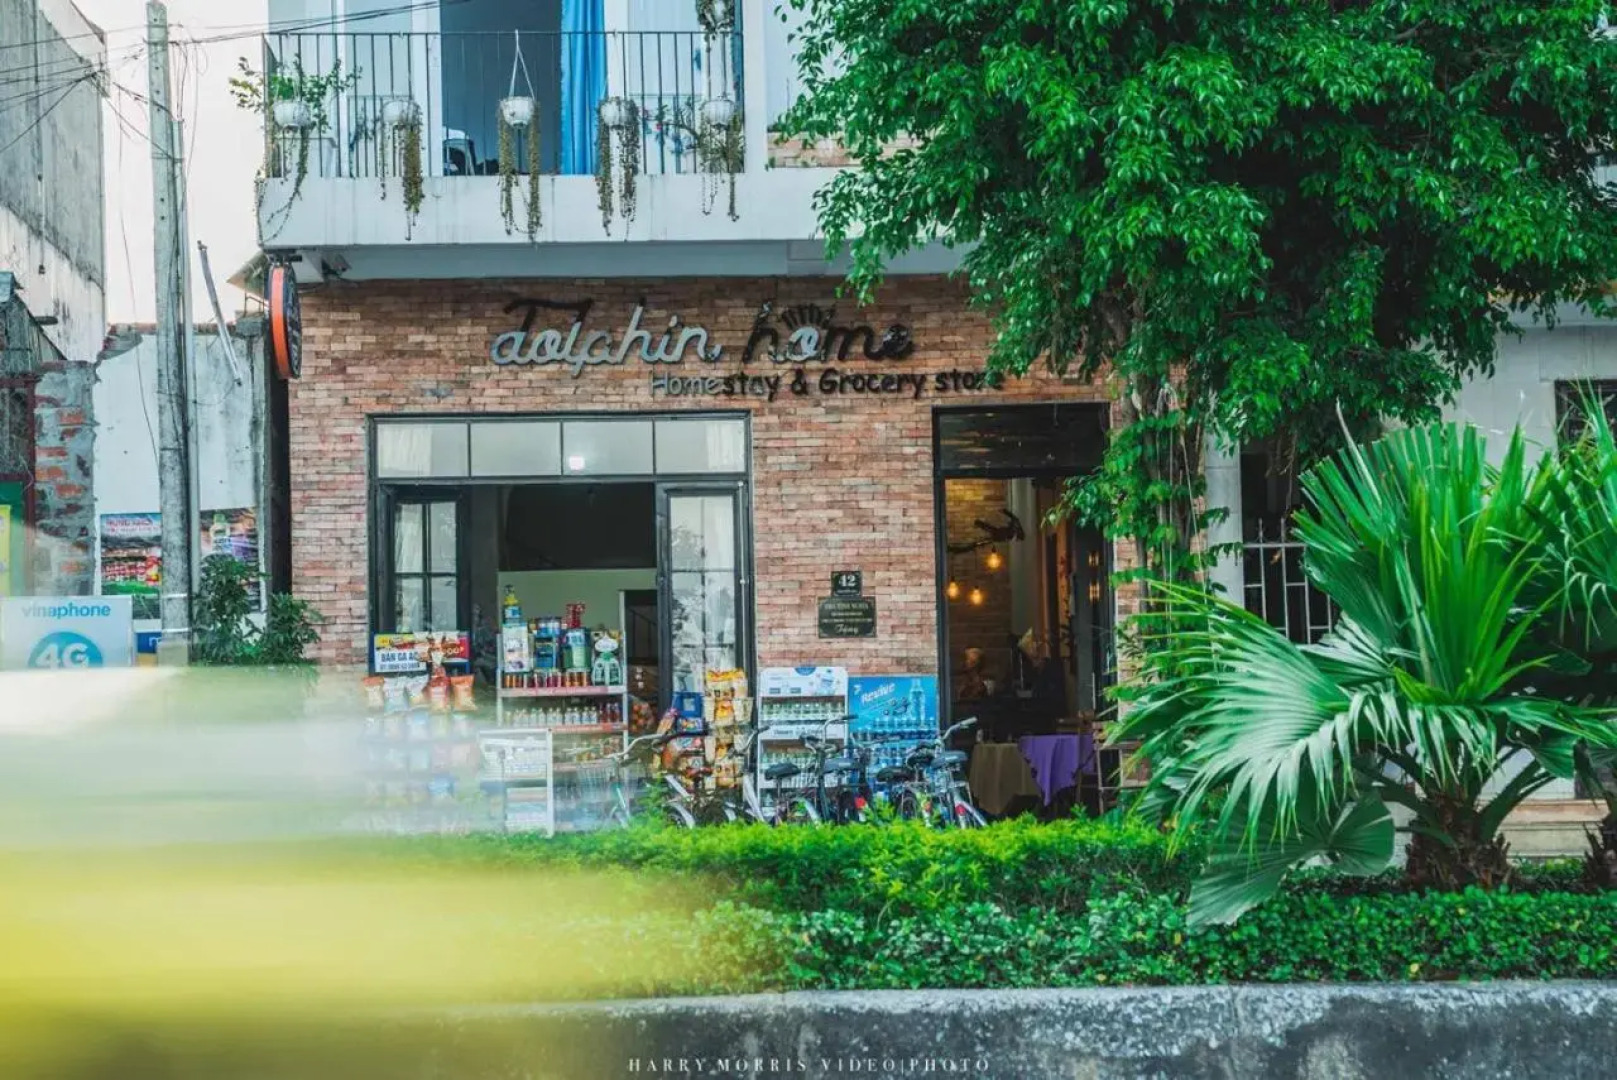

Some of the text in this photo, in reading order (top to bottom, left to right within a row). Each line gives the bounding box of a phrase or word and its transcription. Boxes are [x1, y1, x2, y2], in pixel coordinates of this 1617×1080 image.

[648, 370, 781, 403] Homestay
[791, 368, 809, 396] &
[819, 367, 927, 400] Grocery
[22, 602, 111, 619] vinaphone
